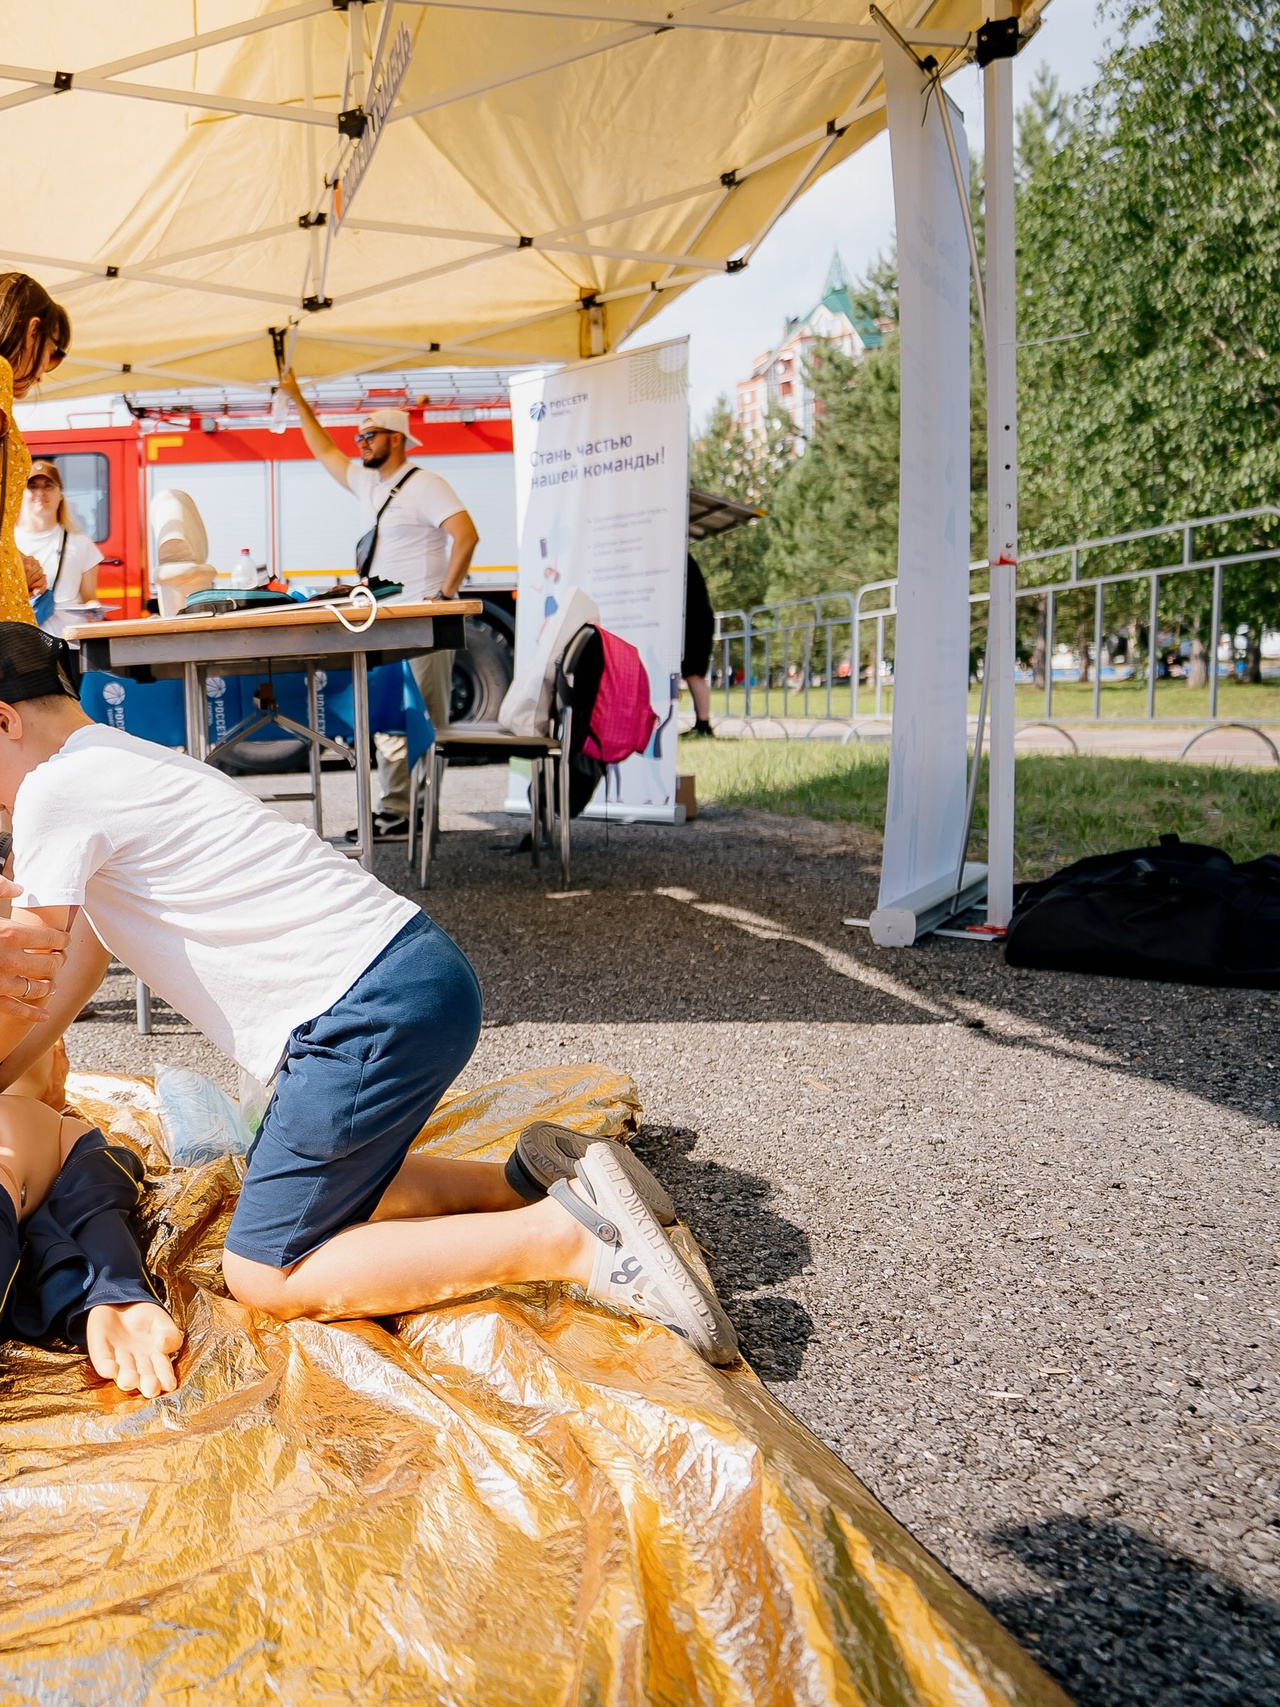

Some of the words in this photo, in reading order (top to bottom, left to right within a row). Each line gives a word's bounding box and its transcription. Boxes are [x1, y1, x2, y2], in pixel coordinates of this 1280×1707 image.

[530, 449, 572, 467] Стань
[577, 434, 633, 456] частью
[531, 464, 578, 490] нашей
[583, 446, 666, 479] команды!
